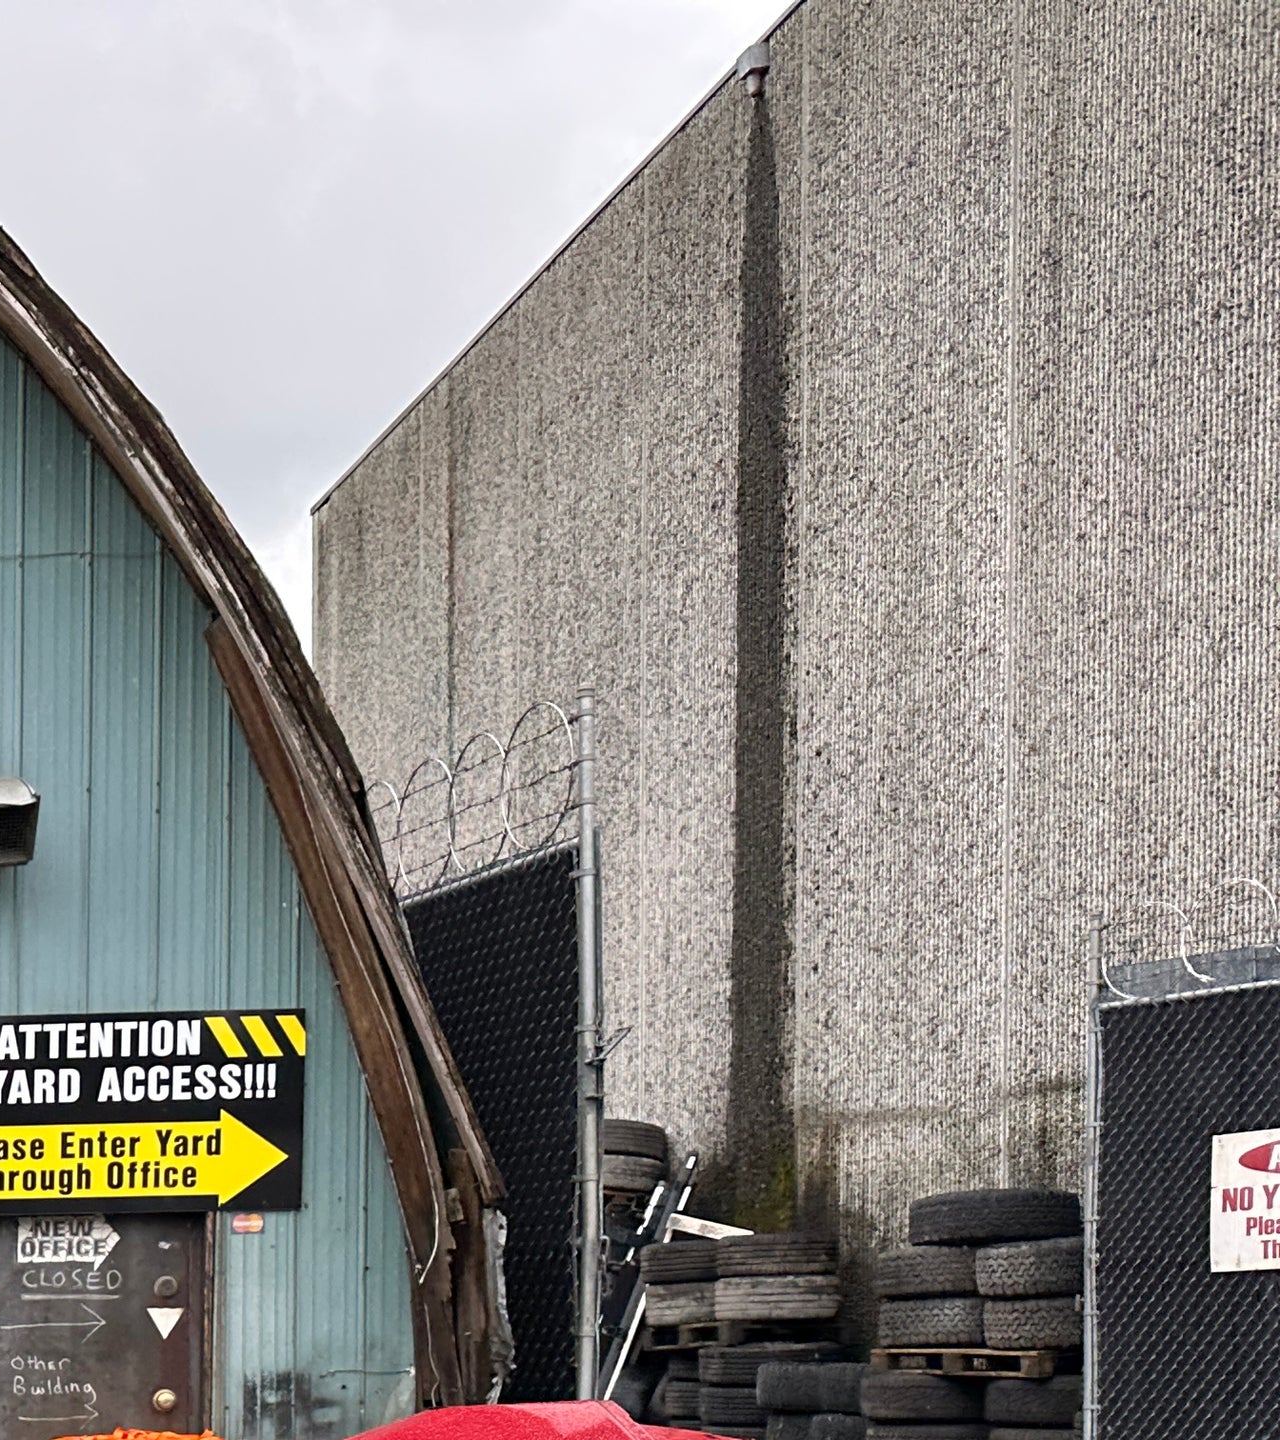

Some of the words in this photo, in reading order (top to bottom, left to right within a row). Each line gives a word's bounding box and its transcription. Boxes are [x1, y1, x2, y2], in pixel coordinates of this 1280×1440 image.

[96, 1062, 278, 1102] ACCESS!!!
[60, 1131, 141, 1159] Enter
[155, 1128, 223, 1157] Yard
[106, 1161, 198, 1189] Office
[1221, 1186, 1254, 1213] NO
[32, 1219, 93, 1237] NEW
[21, 1238, 107, 1258] OFFICE
[22, 1268, 122, 1291] CLOSED
[11, 1355, 71, 1371] Other
[12, 1376, 97, 1403] Building
